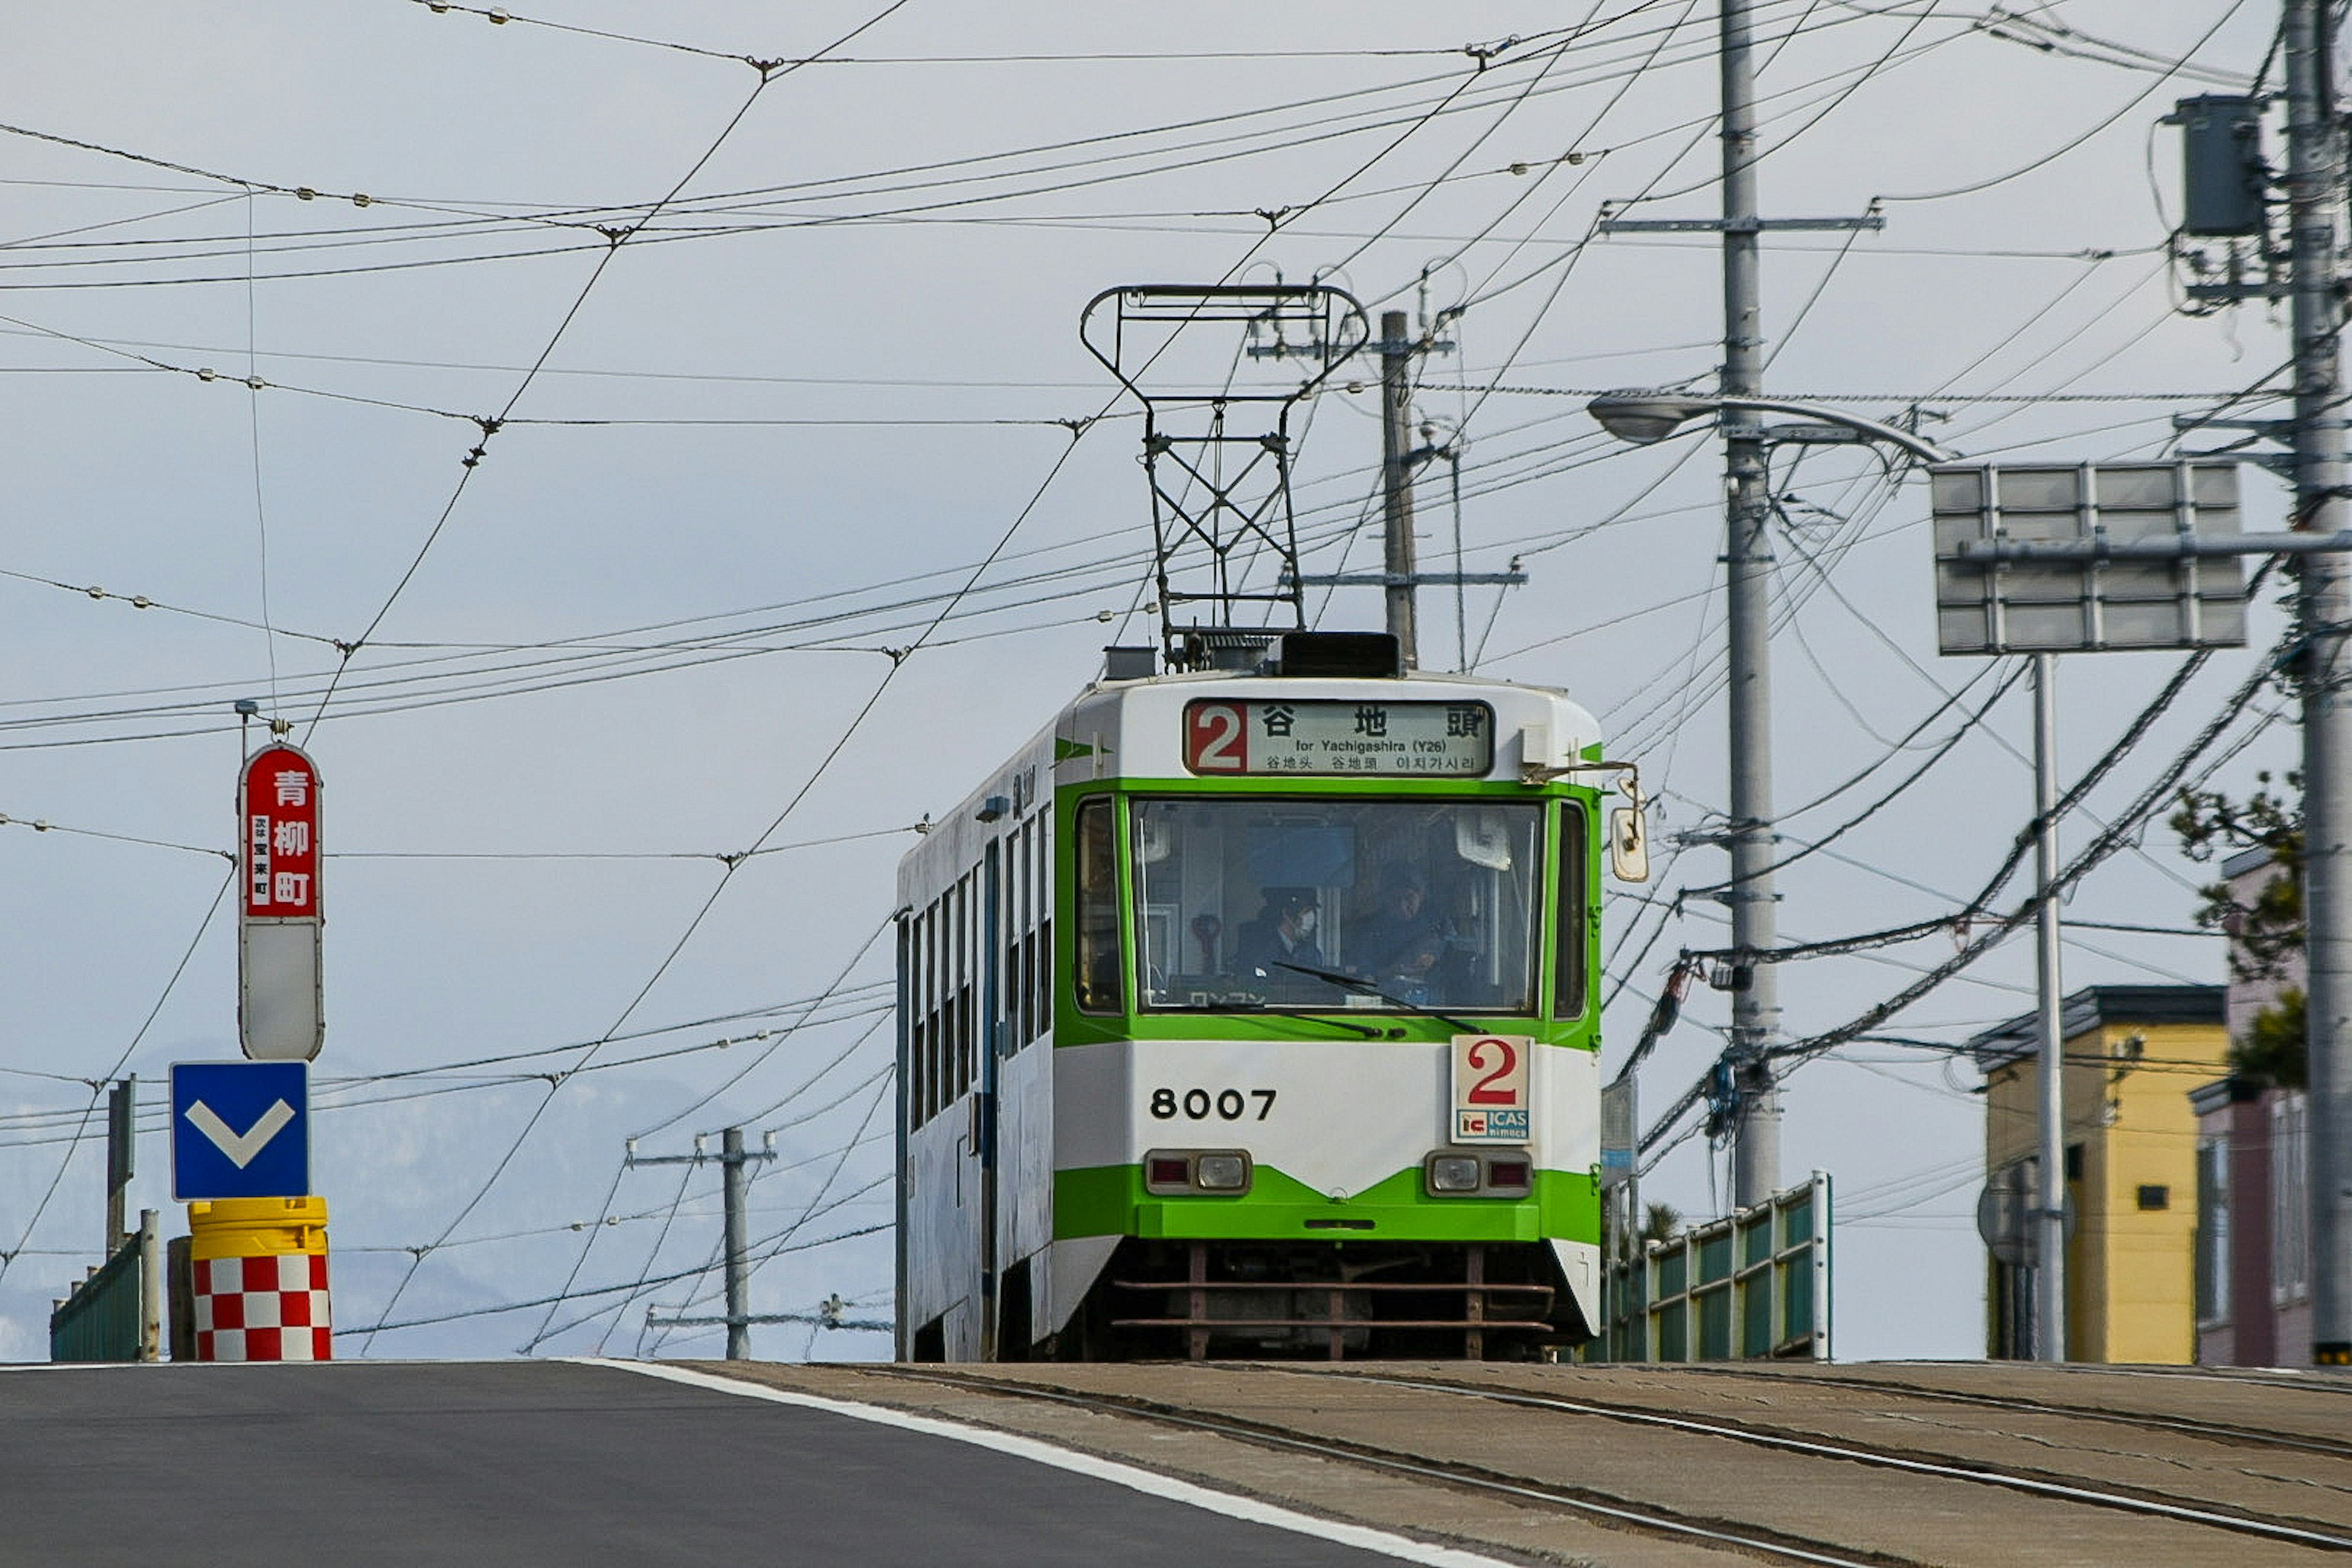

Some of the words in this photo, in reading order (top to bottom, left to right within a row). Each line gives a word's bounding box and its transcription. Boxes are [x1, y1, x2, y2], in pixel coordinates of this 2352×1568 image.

[1198, 705, 1241, 768] 2
[1263, 705, 1485, 737] 谷地頭
[1296, 739, 1314, 752] for
[1322, 740, 1405, 754] Yachigashira
[1412, 739, 1446, 753] (Y26)
[274, 770, 309, 907] 青柳町
[1468, 1039, 1516, 1105] 2
[1150, 1088, 1277, 1120] 8007
[1490, 1111, 1526, 1126] ICAS
